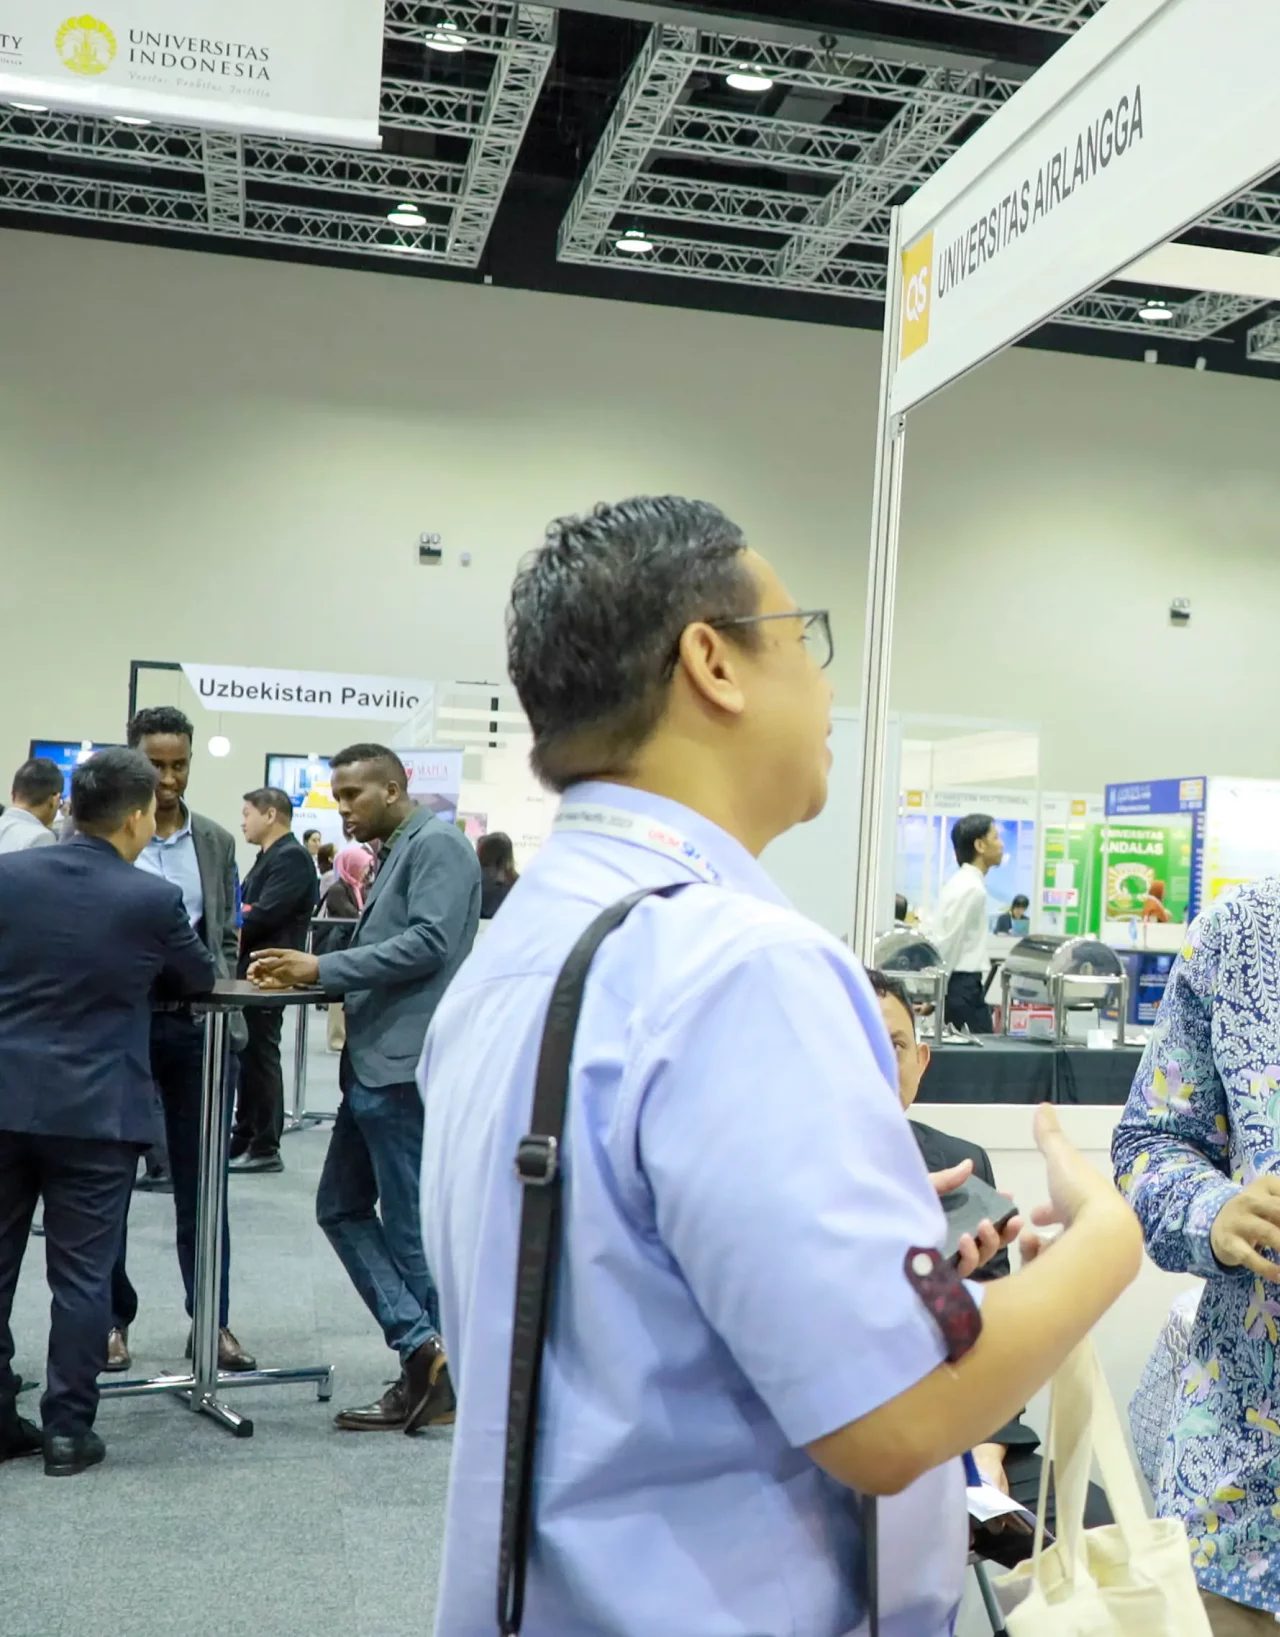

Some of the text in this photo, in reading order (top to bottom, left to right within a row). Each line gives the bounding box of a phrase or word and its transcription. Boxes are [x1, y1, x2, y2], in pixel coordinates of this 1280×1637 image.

[129, 29, 269, 62] UNIVERSITAS
[129, 48, 270, 81] INDONESIA
[906, 84, 1144, 322] QS UNIVERSITAS AIRLANGGA
[199, 677, 332, 704] Uzbekistan
[1100, 841, 1164, 856] ANDALAS
